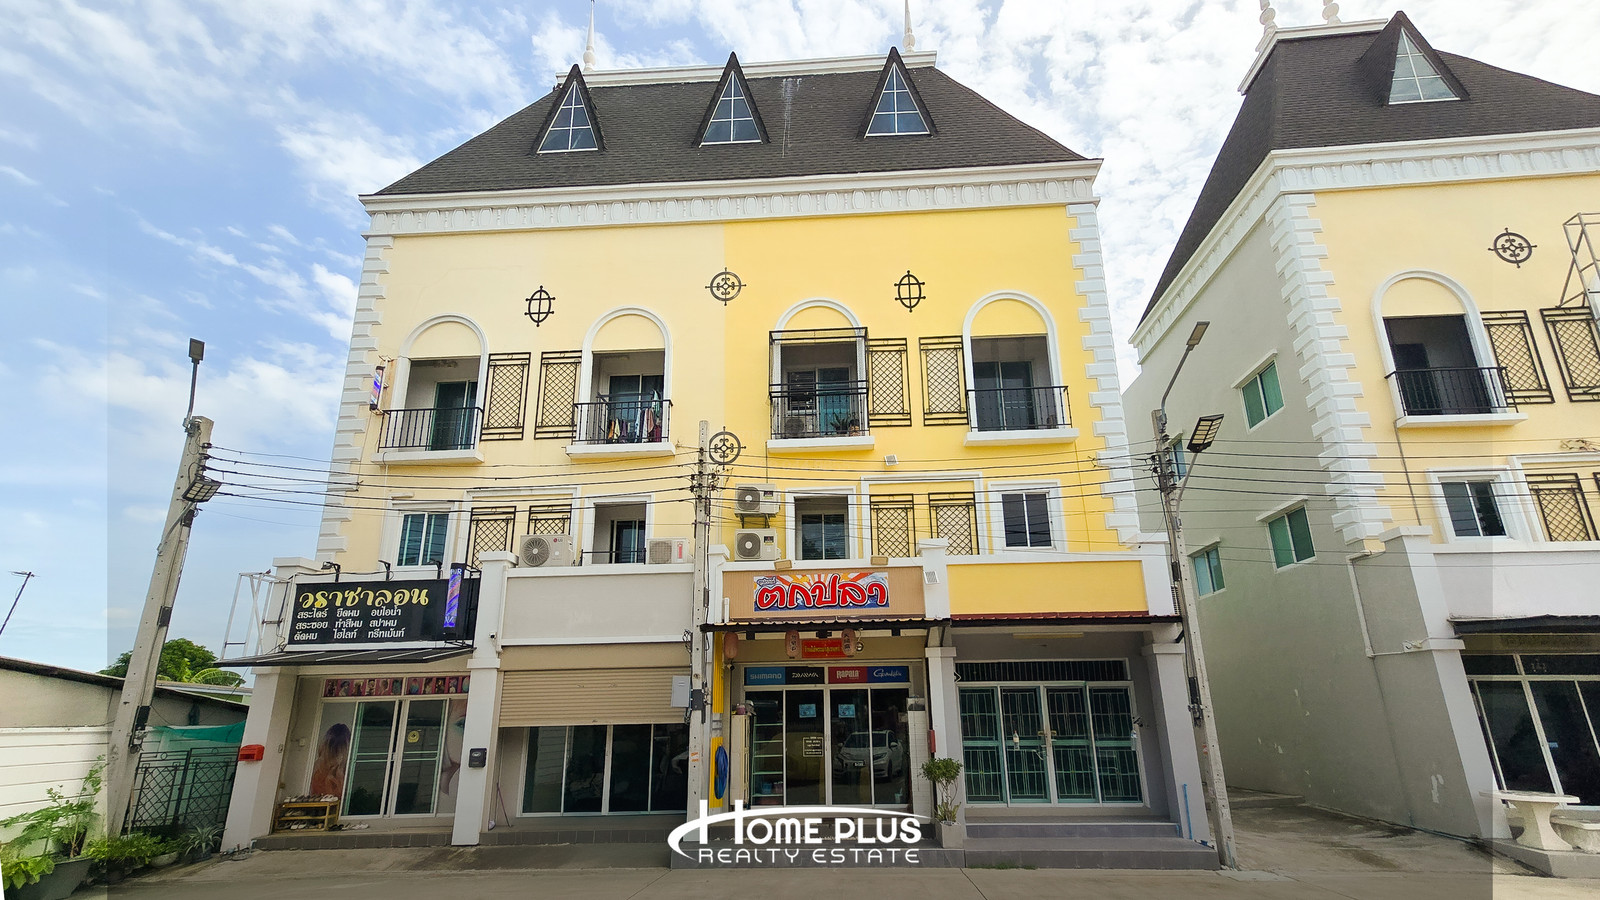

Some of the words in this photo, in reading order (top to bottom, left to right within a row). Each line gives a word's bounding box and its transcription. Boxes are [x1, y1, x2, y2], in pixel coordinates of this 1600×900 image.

[299, 587, 429, 608] วราซาลอน
[756, 573, 888, 610] ตกปลา
[297, 608, 329, 618] สระไดร์
[295, 621, 329, 630] สระซอย
[335, 618, 363, 628] ทำสีผม
[369, 618, 397, 627] สปาผม
[294, 631, 318, 640] ดัดผม
